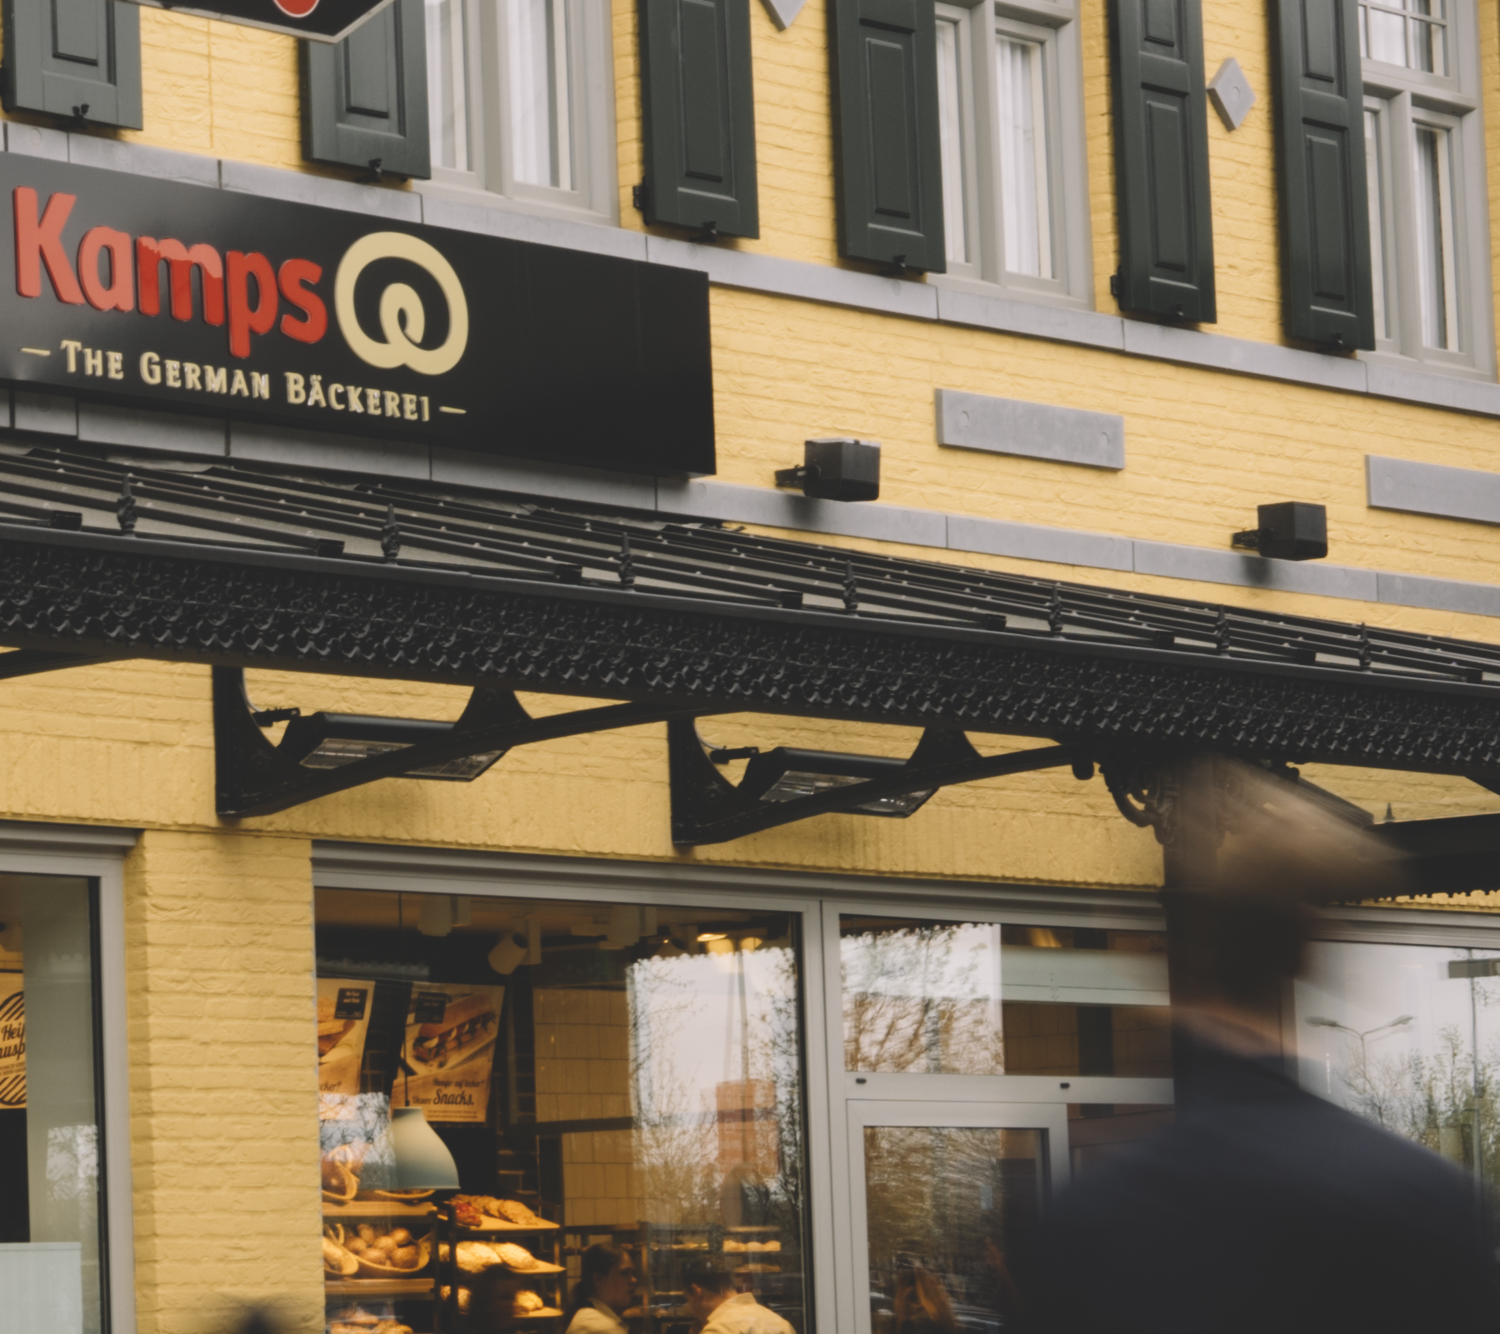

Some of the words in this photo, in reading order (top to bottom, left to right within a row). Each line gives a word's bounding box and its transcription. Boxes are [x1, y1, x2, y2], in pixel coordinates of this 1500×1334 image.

[12, 185, 328, 359] Kamps
[60, 339, 124, 380] THE
[140, 351, 270, 401] GERMAN
[286, 372, 431, 422] BÄCKEREI
[433, 1088, 475, 1105] Snacks.
